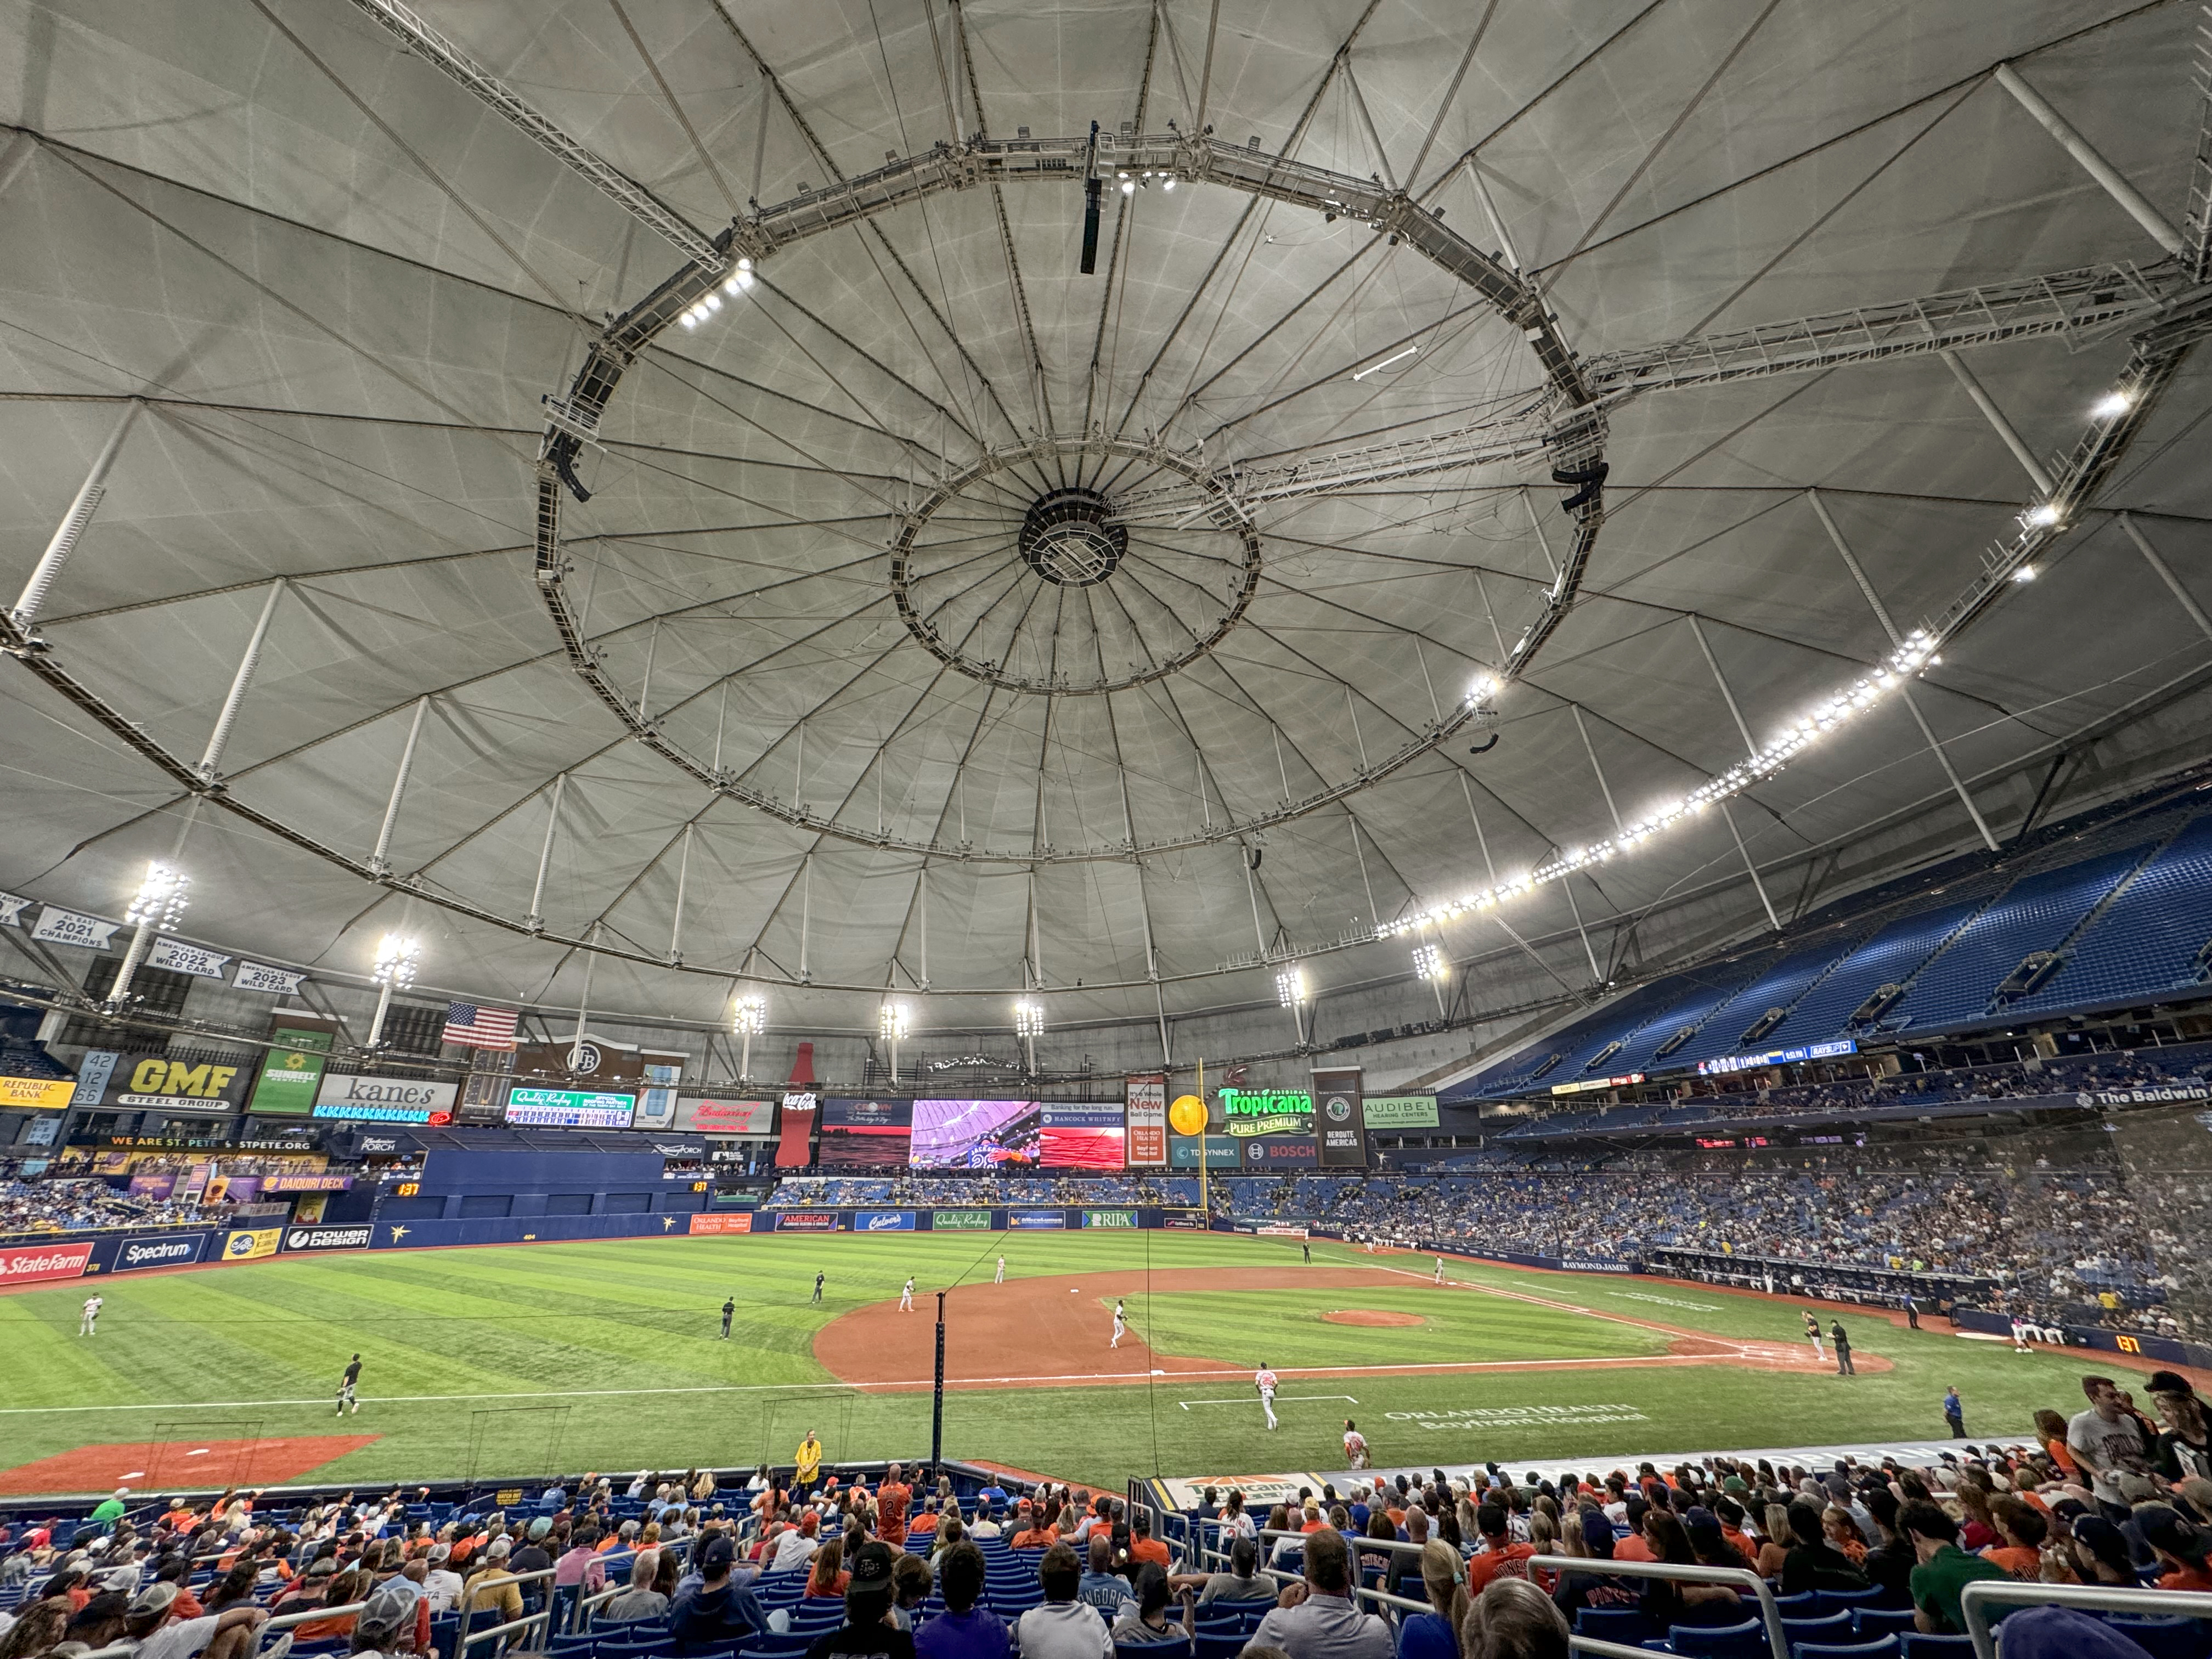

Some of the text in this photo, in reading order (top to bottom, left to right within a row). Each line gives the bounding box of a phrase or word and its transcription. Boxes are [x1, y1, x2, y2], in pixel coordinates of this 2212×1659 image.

[55, 920, 94, 936] 2021
[76, 916, 97, 926] EAST
[40, 929, 103, 947] CHAMPIONS
[156, 941, 225, 961] AMERICAN LEAGUE
[168, 950, 208, 966] 2022
[155, 956, 215, 975] WILD CARD
[241, 964, 301, 979] AMERICAN LEAGUE
[241, 978, 293, 993] WILD CARD
[252, 972, 287, 985] 2023
[89, 1054, 111, 1068] 42
[84, 1072, 103, 1085] 12
[129, 1059, 238, 1097] GMF
[266, 1069, 317, 1081] SUNBELT
[3, 1080, 57, 1091] REPUBLIC
[344, 1077, 435, 1104] kane's
[10, 1090, 42, 1098] BANK
[75, 1088, 98, 1102] 66
[517, 1091, 571, 1106] Quality Roofing
[2096, 1086, 2208, 1104] The Baldwin
[127, 1096, 223, 1108] STEEL GROUP
[1130, 1098, 1162, 1110] New
[1218, 1088, 1312, 1116] Tropicana
[1364, 1102, 1437, 1114] AUDIBEL
[1229, 1117, 1301, 1133] PURE PREMIUM
[111, 1136, 218, 1147] WE ARE ST. PETE
[1327, 1130, 1355, 1139] REROUTE
[240, 1141, 311, 1150] STPETE.ORG
[360, 1143, 395, 1151] PORCH
[1325, 1138, 1358, 1147] AMERICAS
[1270, 1146, 1316, 1157] BOSCH
[279, 1177, 347, 1189] DAIQUIRI DECK
[868, 1214, 902, 1230] Culver's
[936, 1214, 988, 1228] Quality Roofing
[1103, 1213, 1131, 1226] RIPA
[126, 1243, 190, 1264] Spectrum
[1562, 1261, 1629, 1272] RAYMOND JAMES
[1384, 1403, 1641, 1420] ORLANDO HEALTH
[1419, 1412, 1652, 1430] Bayfront Hospital
[884, 1499, 895, 1518] 2
